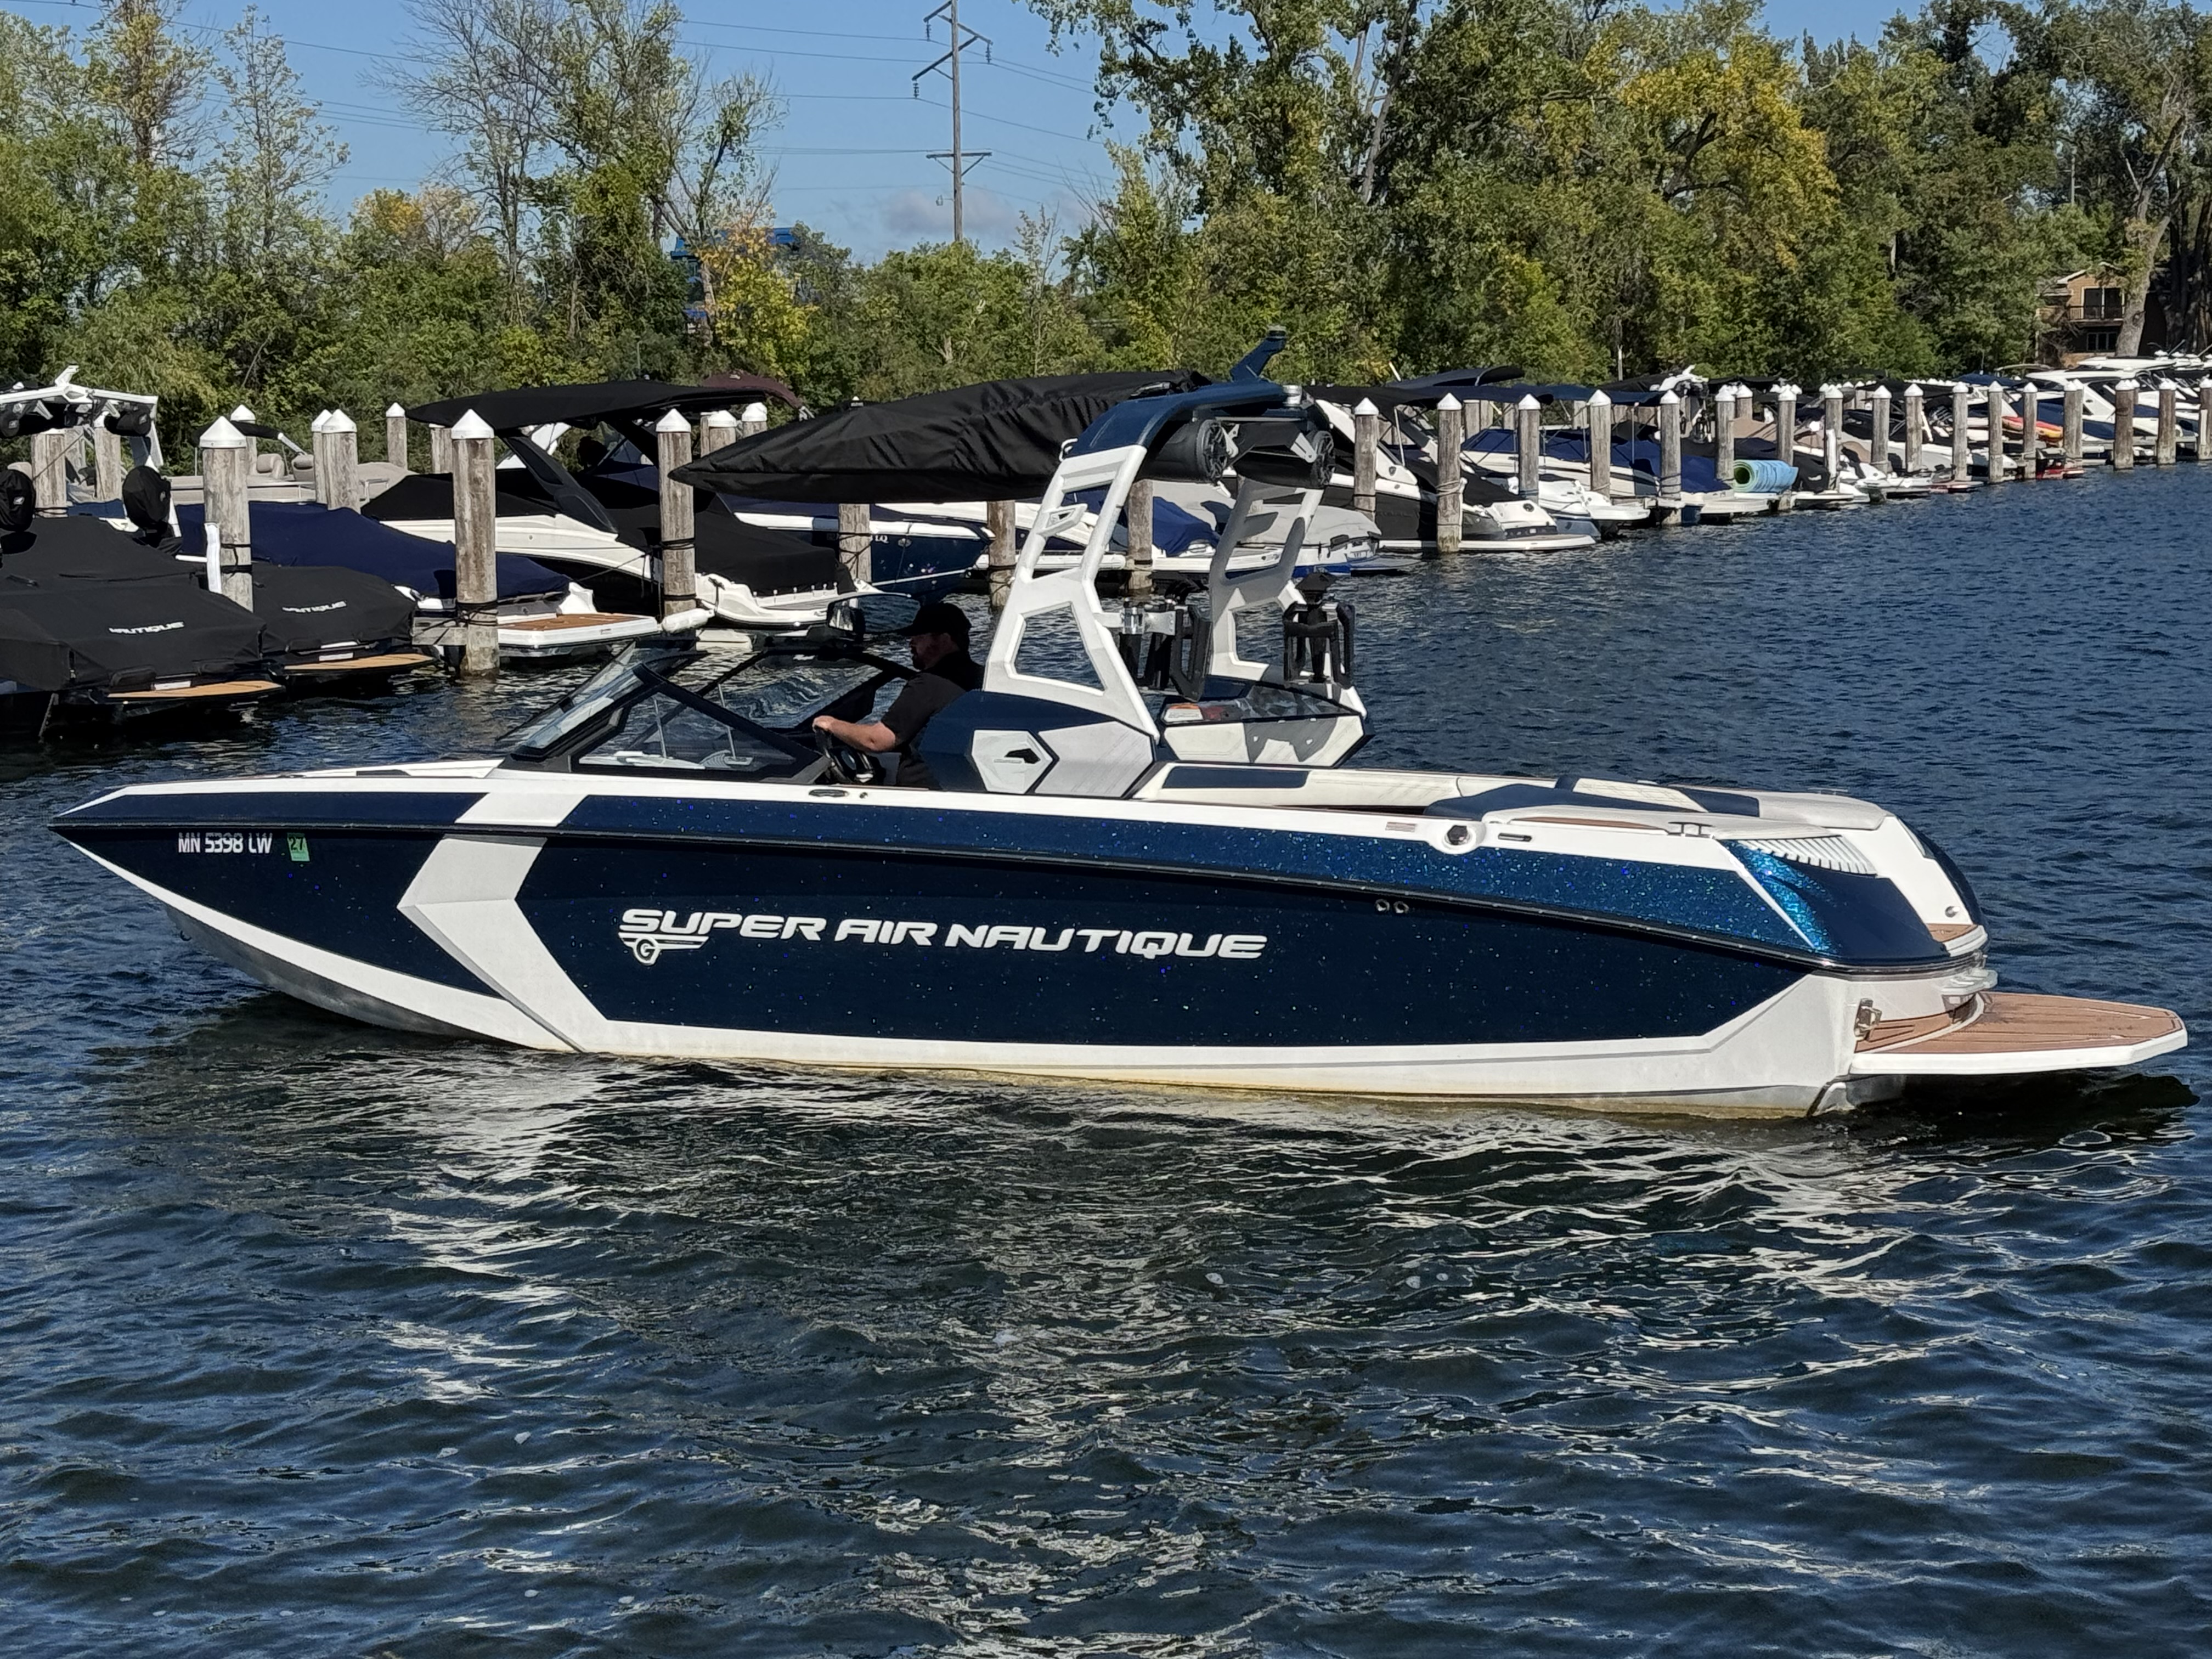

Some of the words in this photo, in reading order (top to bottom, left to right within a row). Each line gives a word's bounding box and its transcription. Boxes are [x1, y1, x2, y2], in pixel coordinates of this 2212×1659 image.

[178, 832, 201, 853] MN
[205, 832, 244, 854] 5398
[249, 832, 273, 854] LW
[289, 836, 304, 850] 27
[619, 909, 827, 941] SUPER
[834, 919, 938, 946] AIR
[945, 923, 1267, 959] NAUTIQUE
